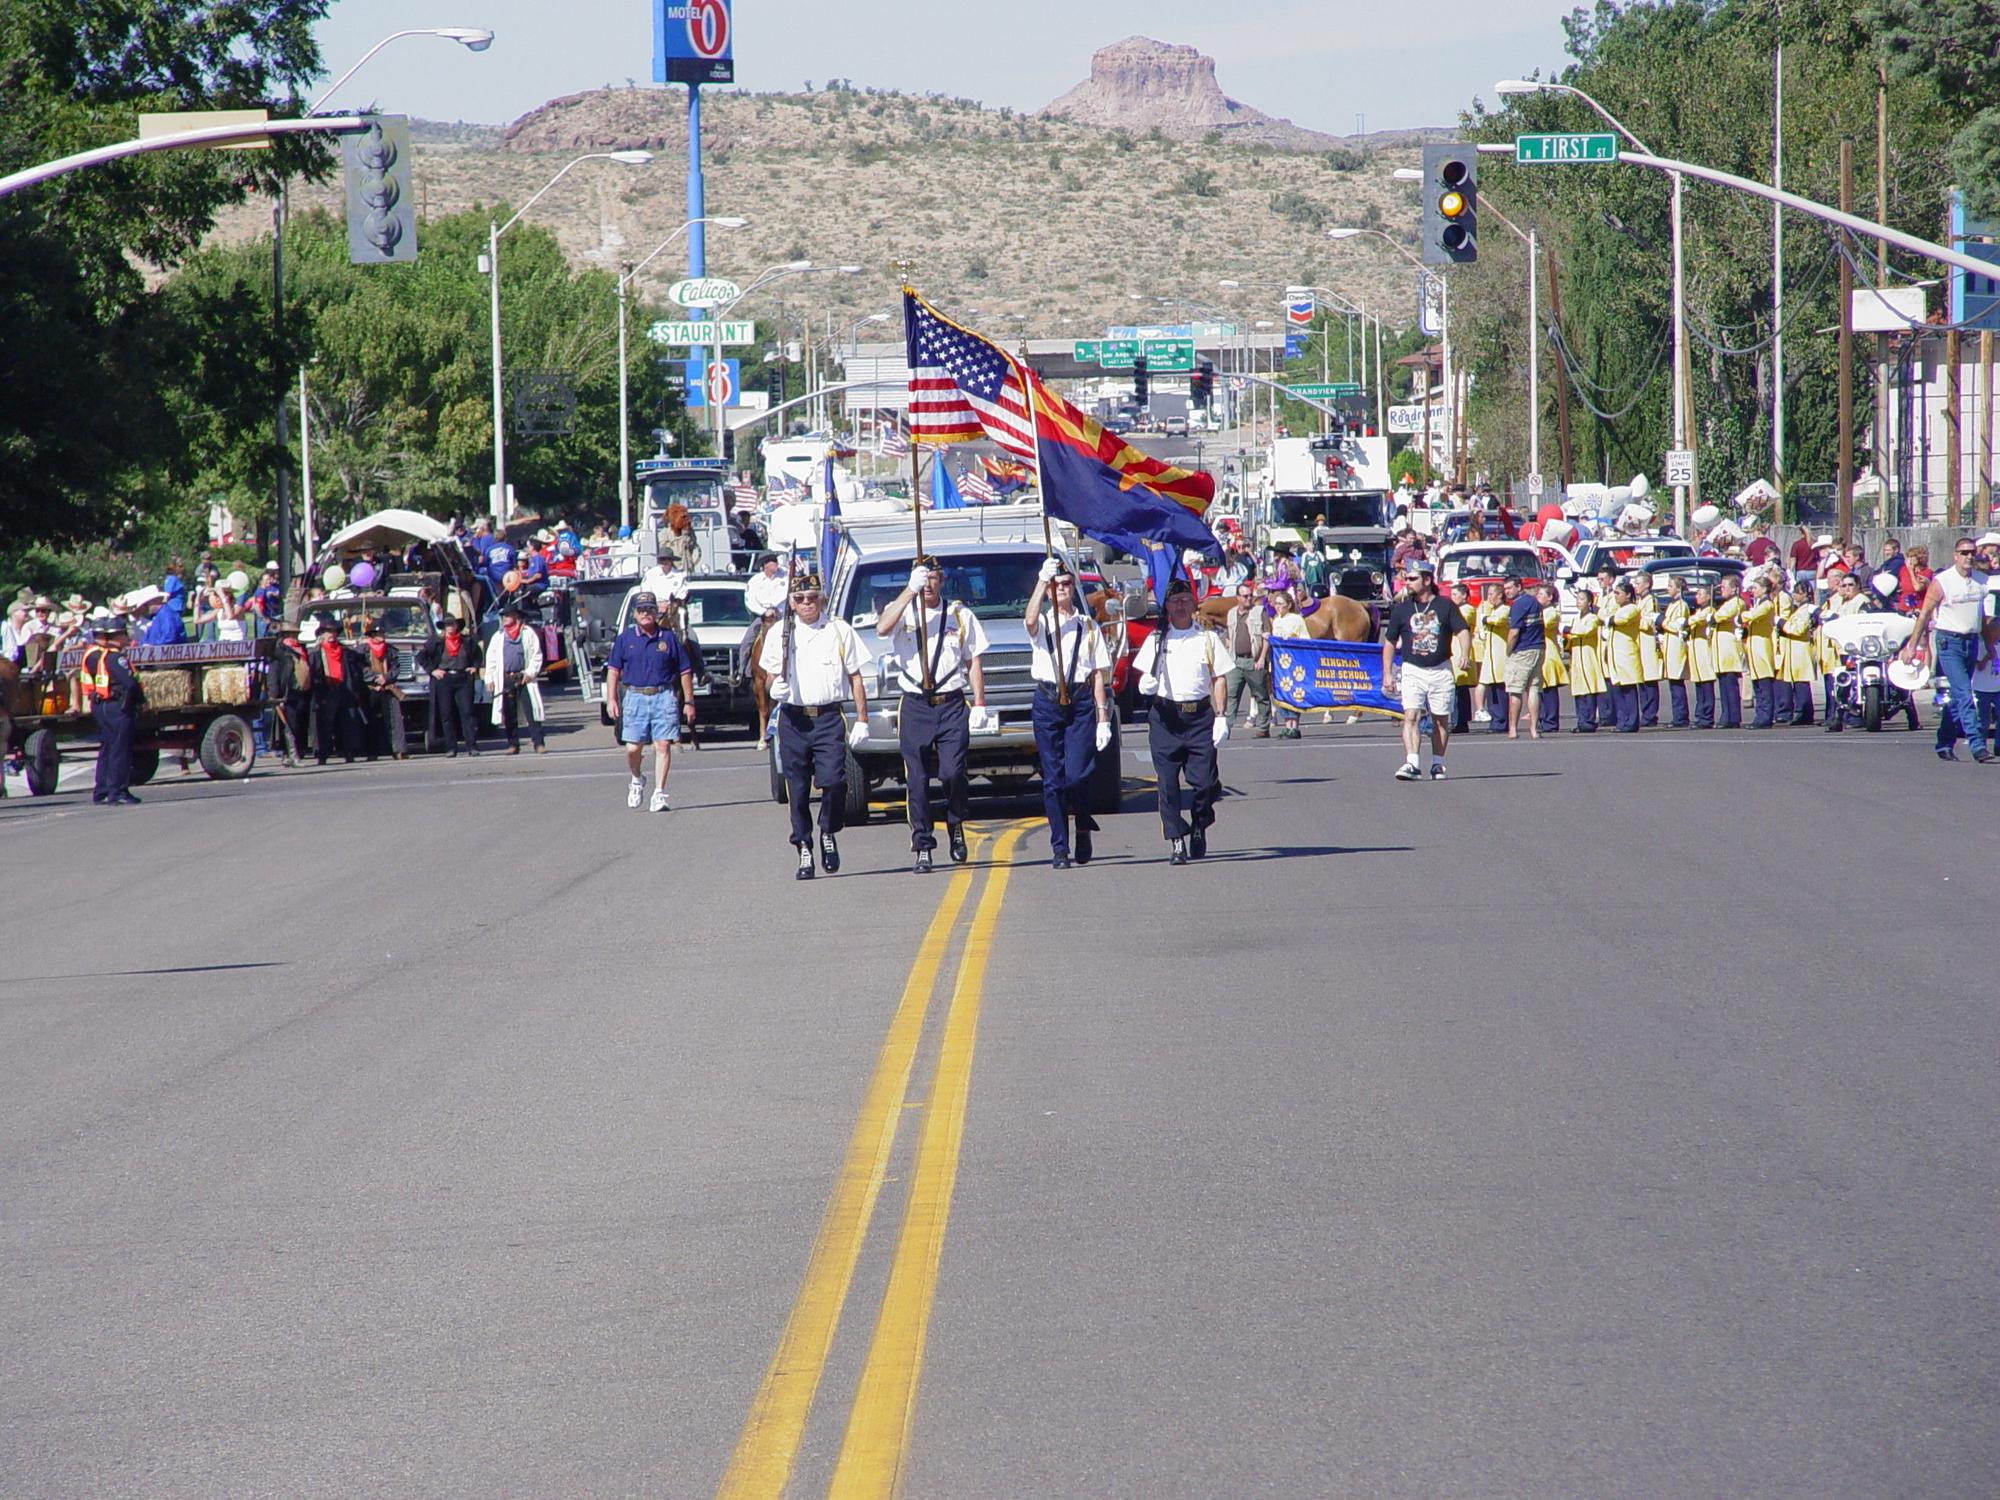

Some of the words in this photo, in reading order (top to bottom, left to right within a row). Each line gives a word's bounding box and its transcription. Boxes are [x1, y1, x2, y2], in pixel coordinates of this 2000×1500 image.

[668, 6, 703, 19] MOTEL
[1525, 149, 1531, 159] N
[1542, 137, 1590, 159] FIRST
[1596, 147, 1607, 158] ST
[678, 281, 735, 304] Calico's
[1292, 388, 1336, 396] RANDVIEW
[1670, 468, 1692, 481] 25
[160, 644, 205, 660] MOHAVE
[209, 640, 254, 657] MUSEUM
[1315, 669, 1336, 678] HIGH
[1338, 670, 1370, 680] SCHOOL
